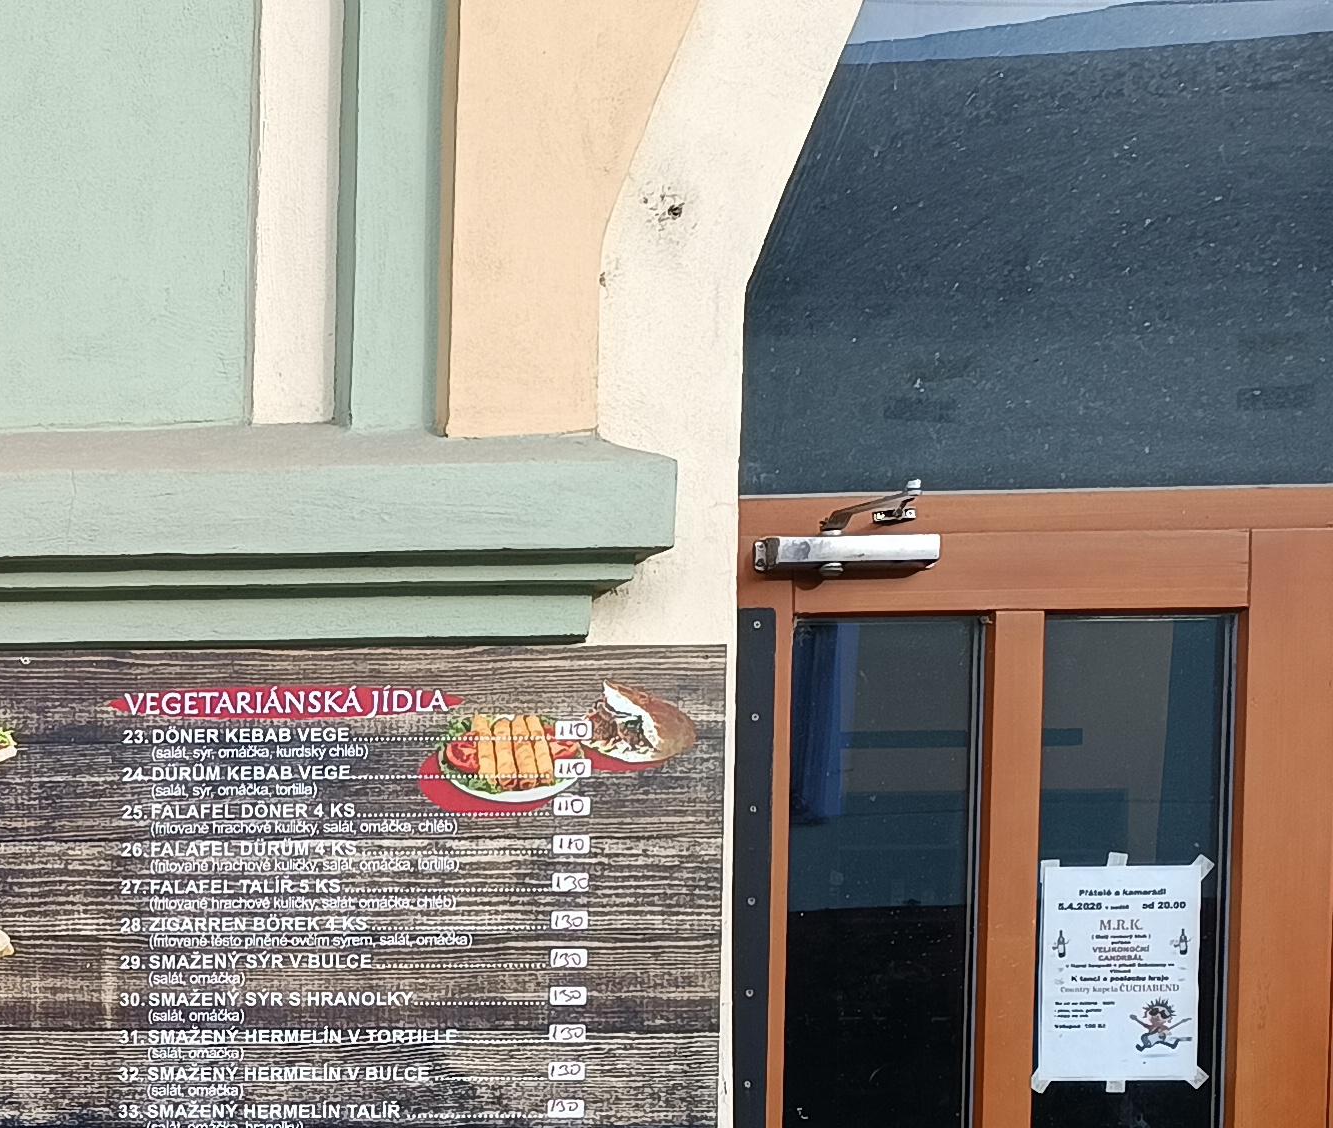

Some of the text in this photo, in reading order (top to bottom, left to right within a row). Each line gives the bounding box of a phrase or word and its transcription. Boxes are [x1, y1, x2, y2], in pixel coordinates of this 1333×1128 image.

[124, 686, 449, 718] VEGETARIÁNSKÁ JÍDLA
[123, 726, 350, 743] 23. DÖNER KEBAB VEGE
[120, 988, 413, 1008] 30. SMAŽENÝ SÝR S HRANOLKY
